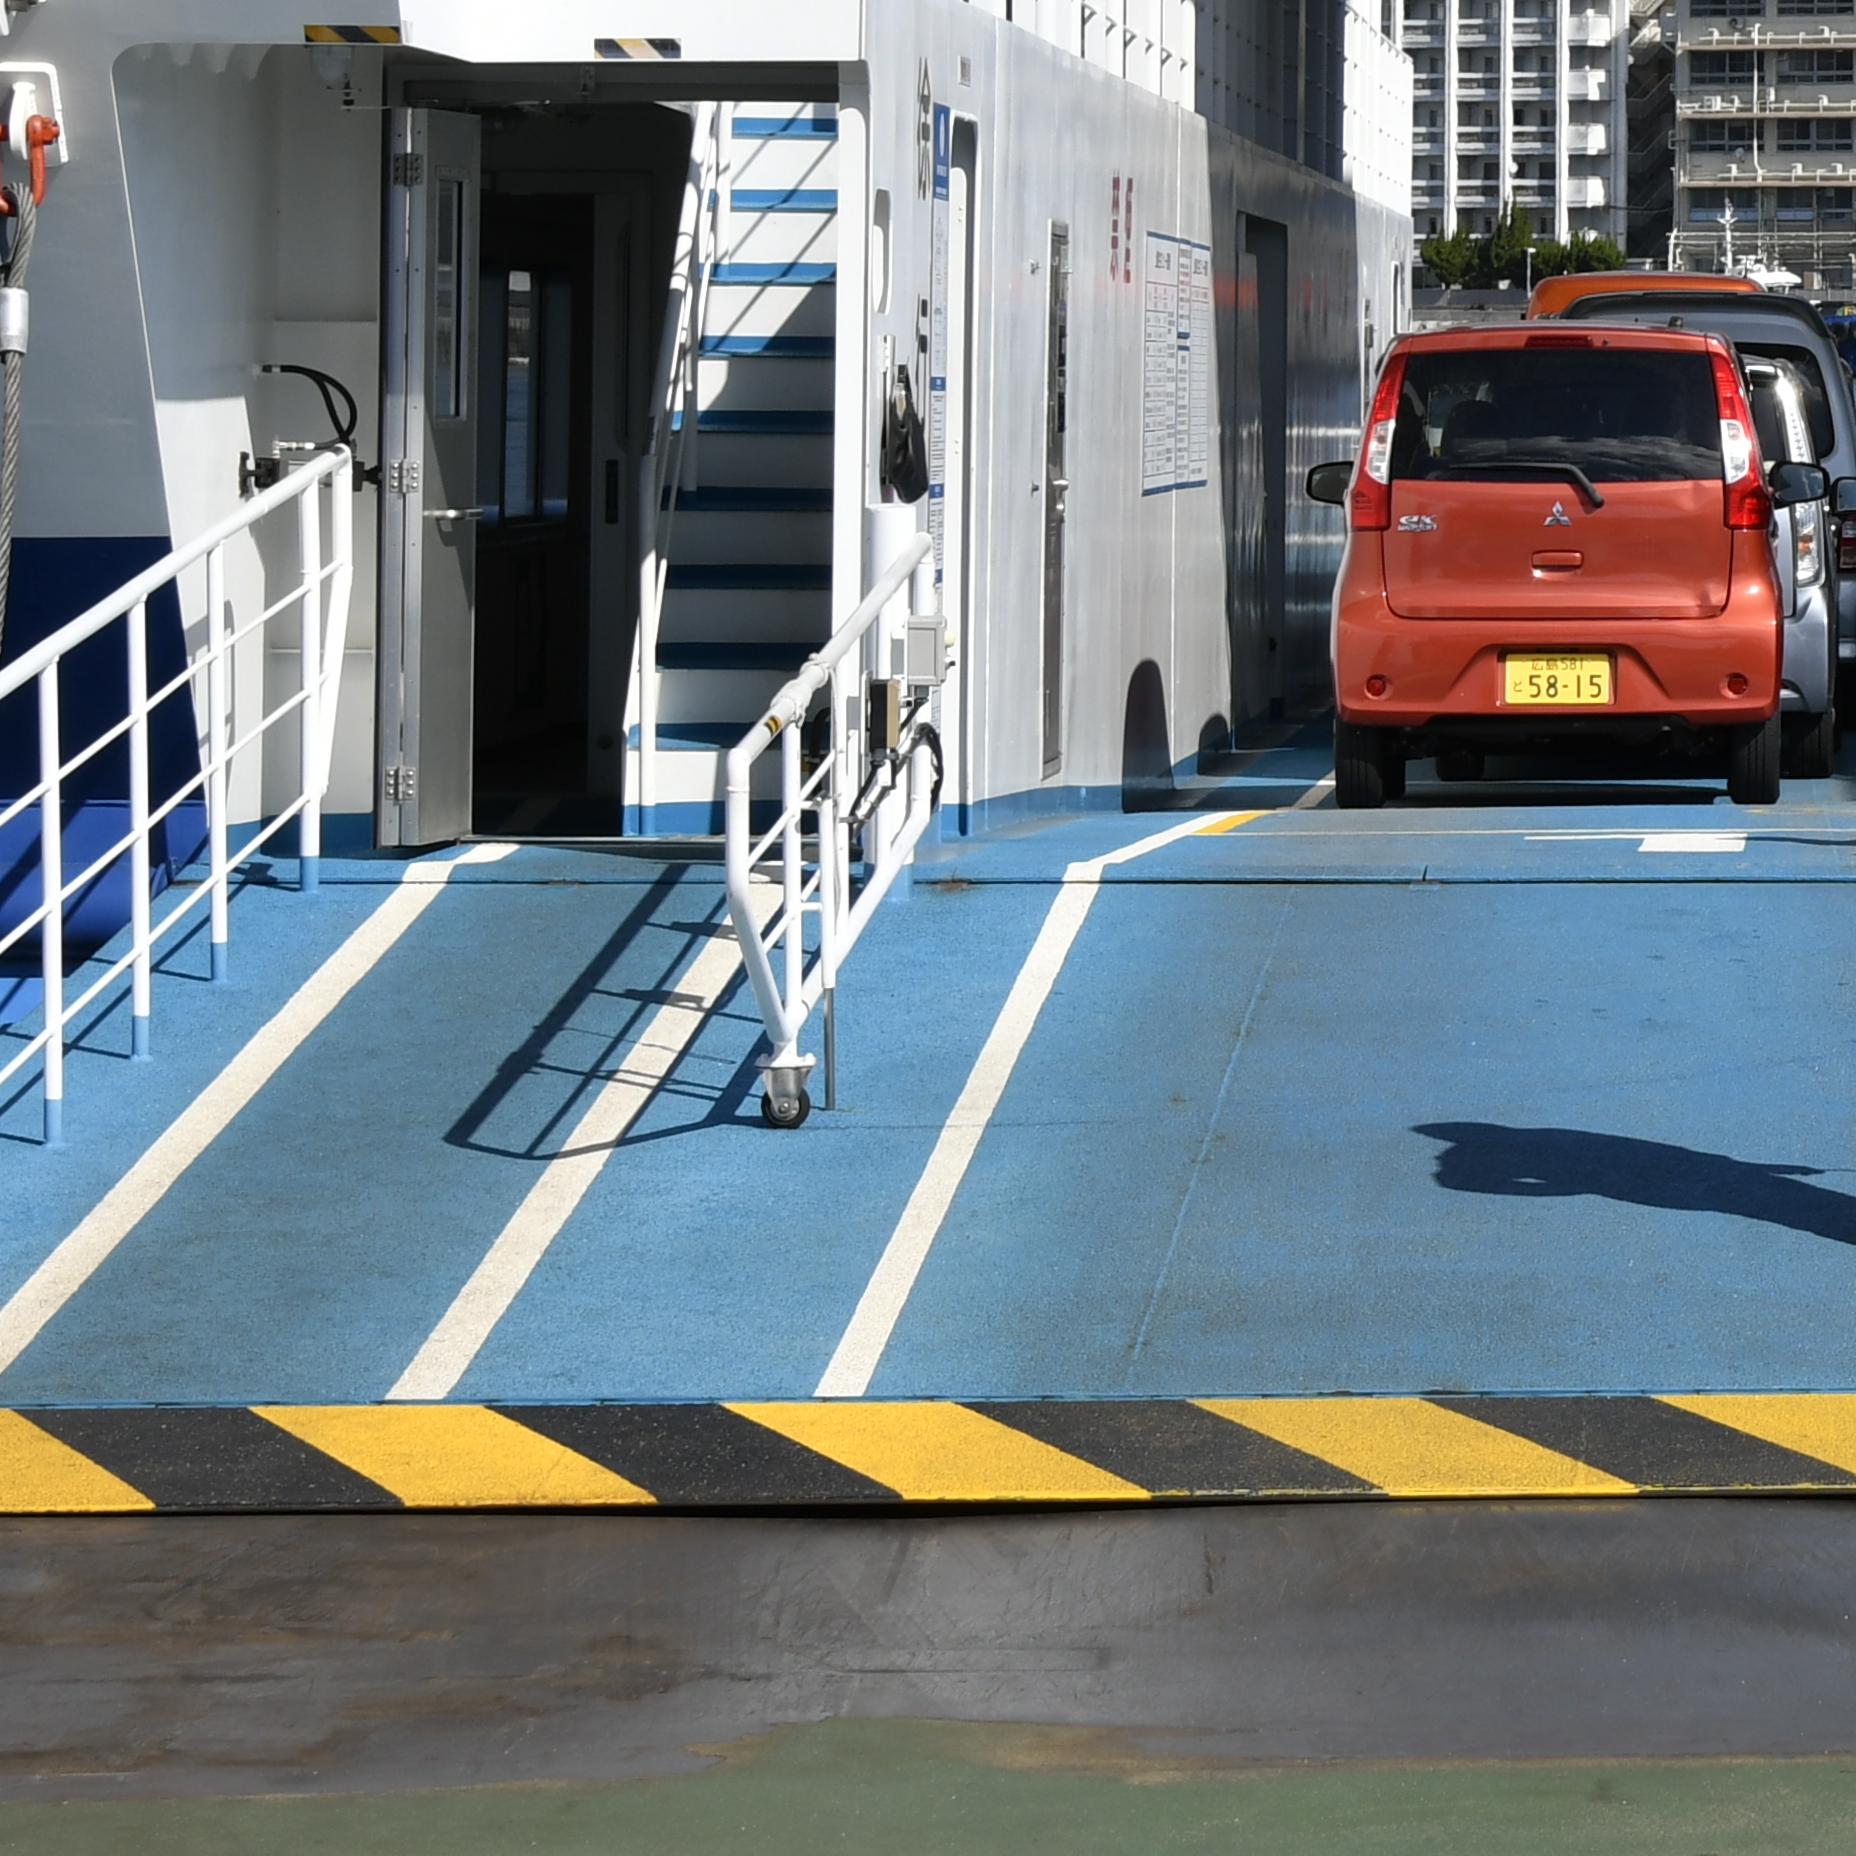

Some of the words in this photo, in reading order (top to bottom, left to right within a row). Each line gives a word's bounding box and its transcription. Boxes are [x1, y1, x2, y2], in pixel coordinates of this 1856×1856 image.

[1531, 657, 1558, 671] 広島
[1561, 657, 1584, 671] 581
[1513, 680, 1523, 693] と
[1528, 674, 1602, 698] 58-15
